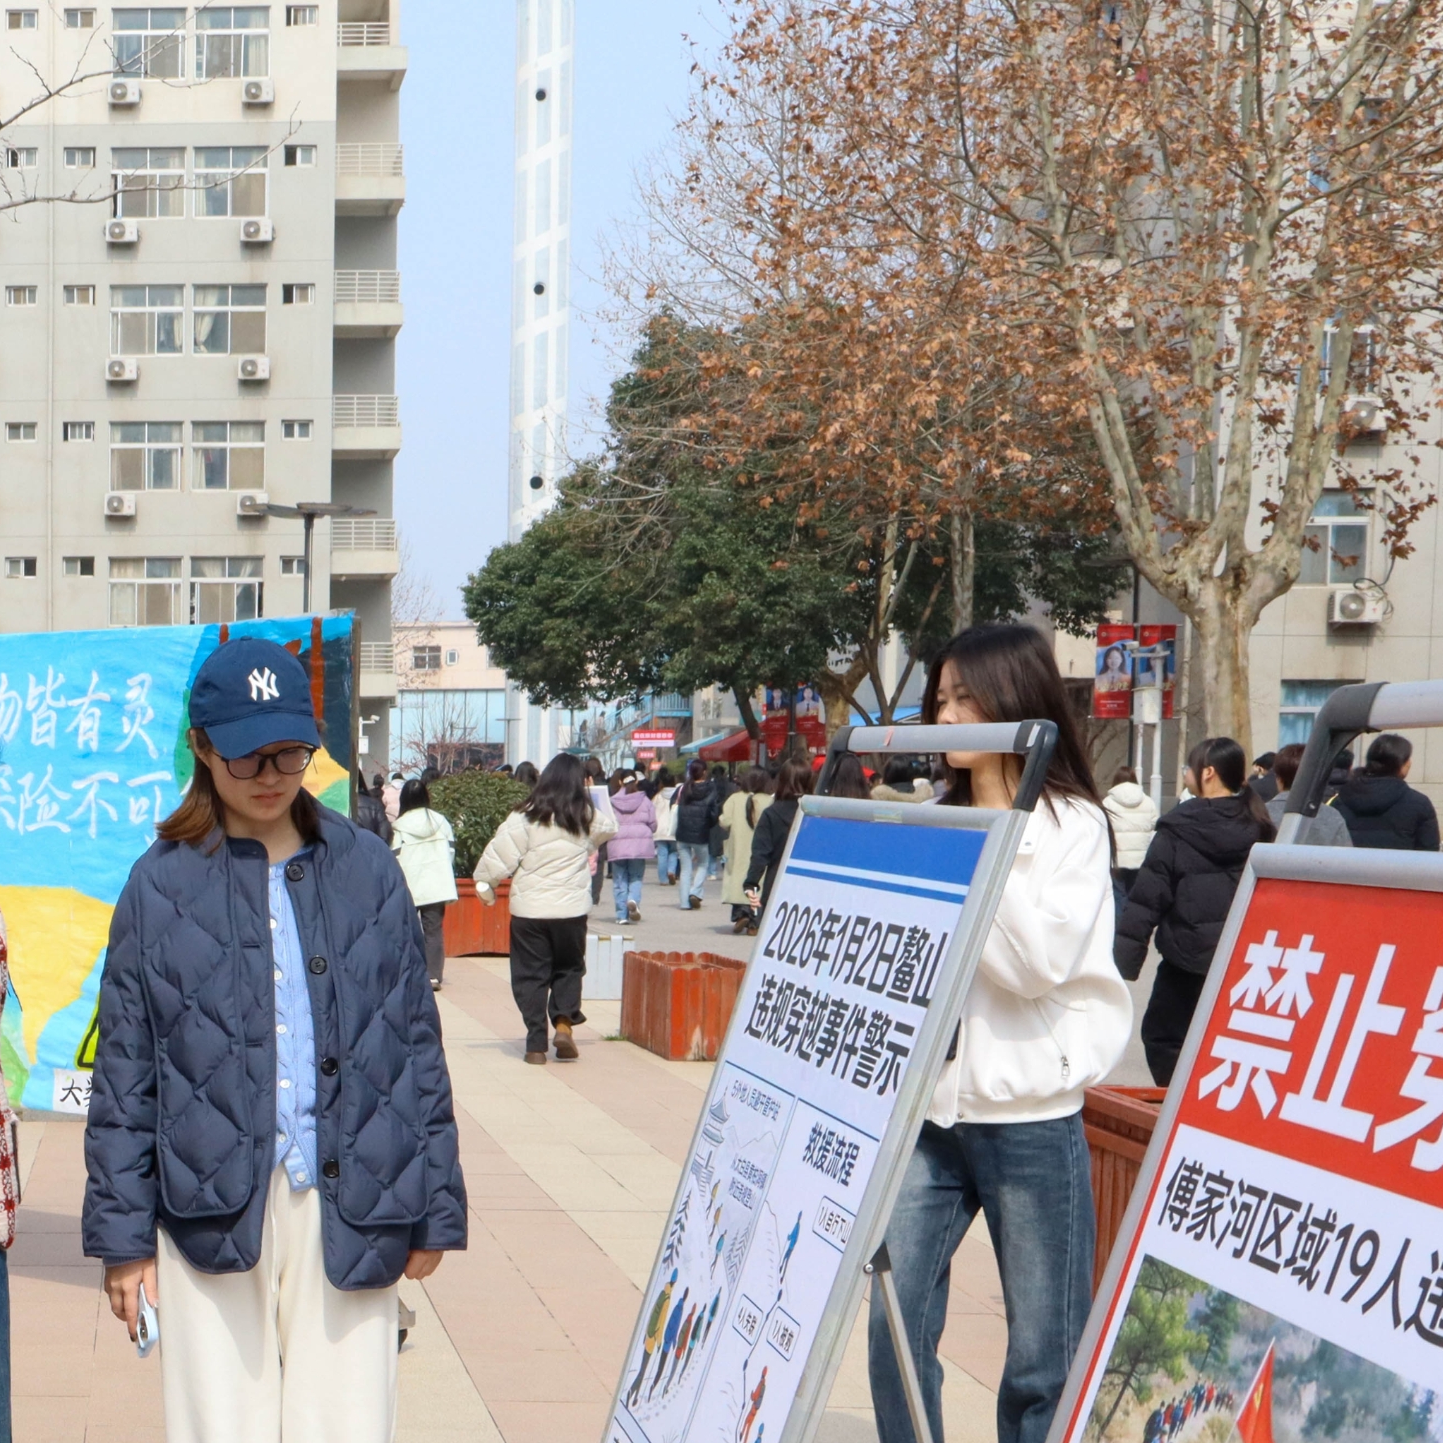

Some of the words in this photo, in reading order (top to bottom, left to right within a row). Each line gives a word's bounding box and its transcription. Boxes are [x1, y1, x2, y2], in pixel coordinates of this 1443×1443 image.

[763, 901, 949, 1009] 2026年1月2日鳌山
[744, 972, 916, 1097] 违规穿越事件警示
[802, 1121, 861, 1187] 救援流程
